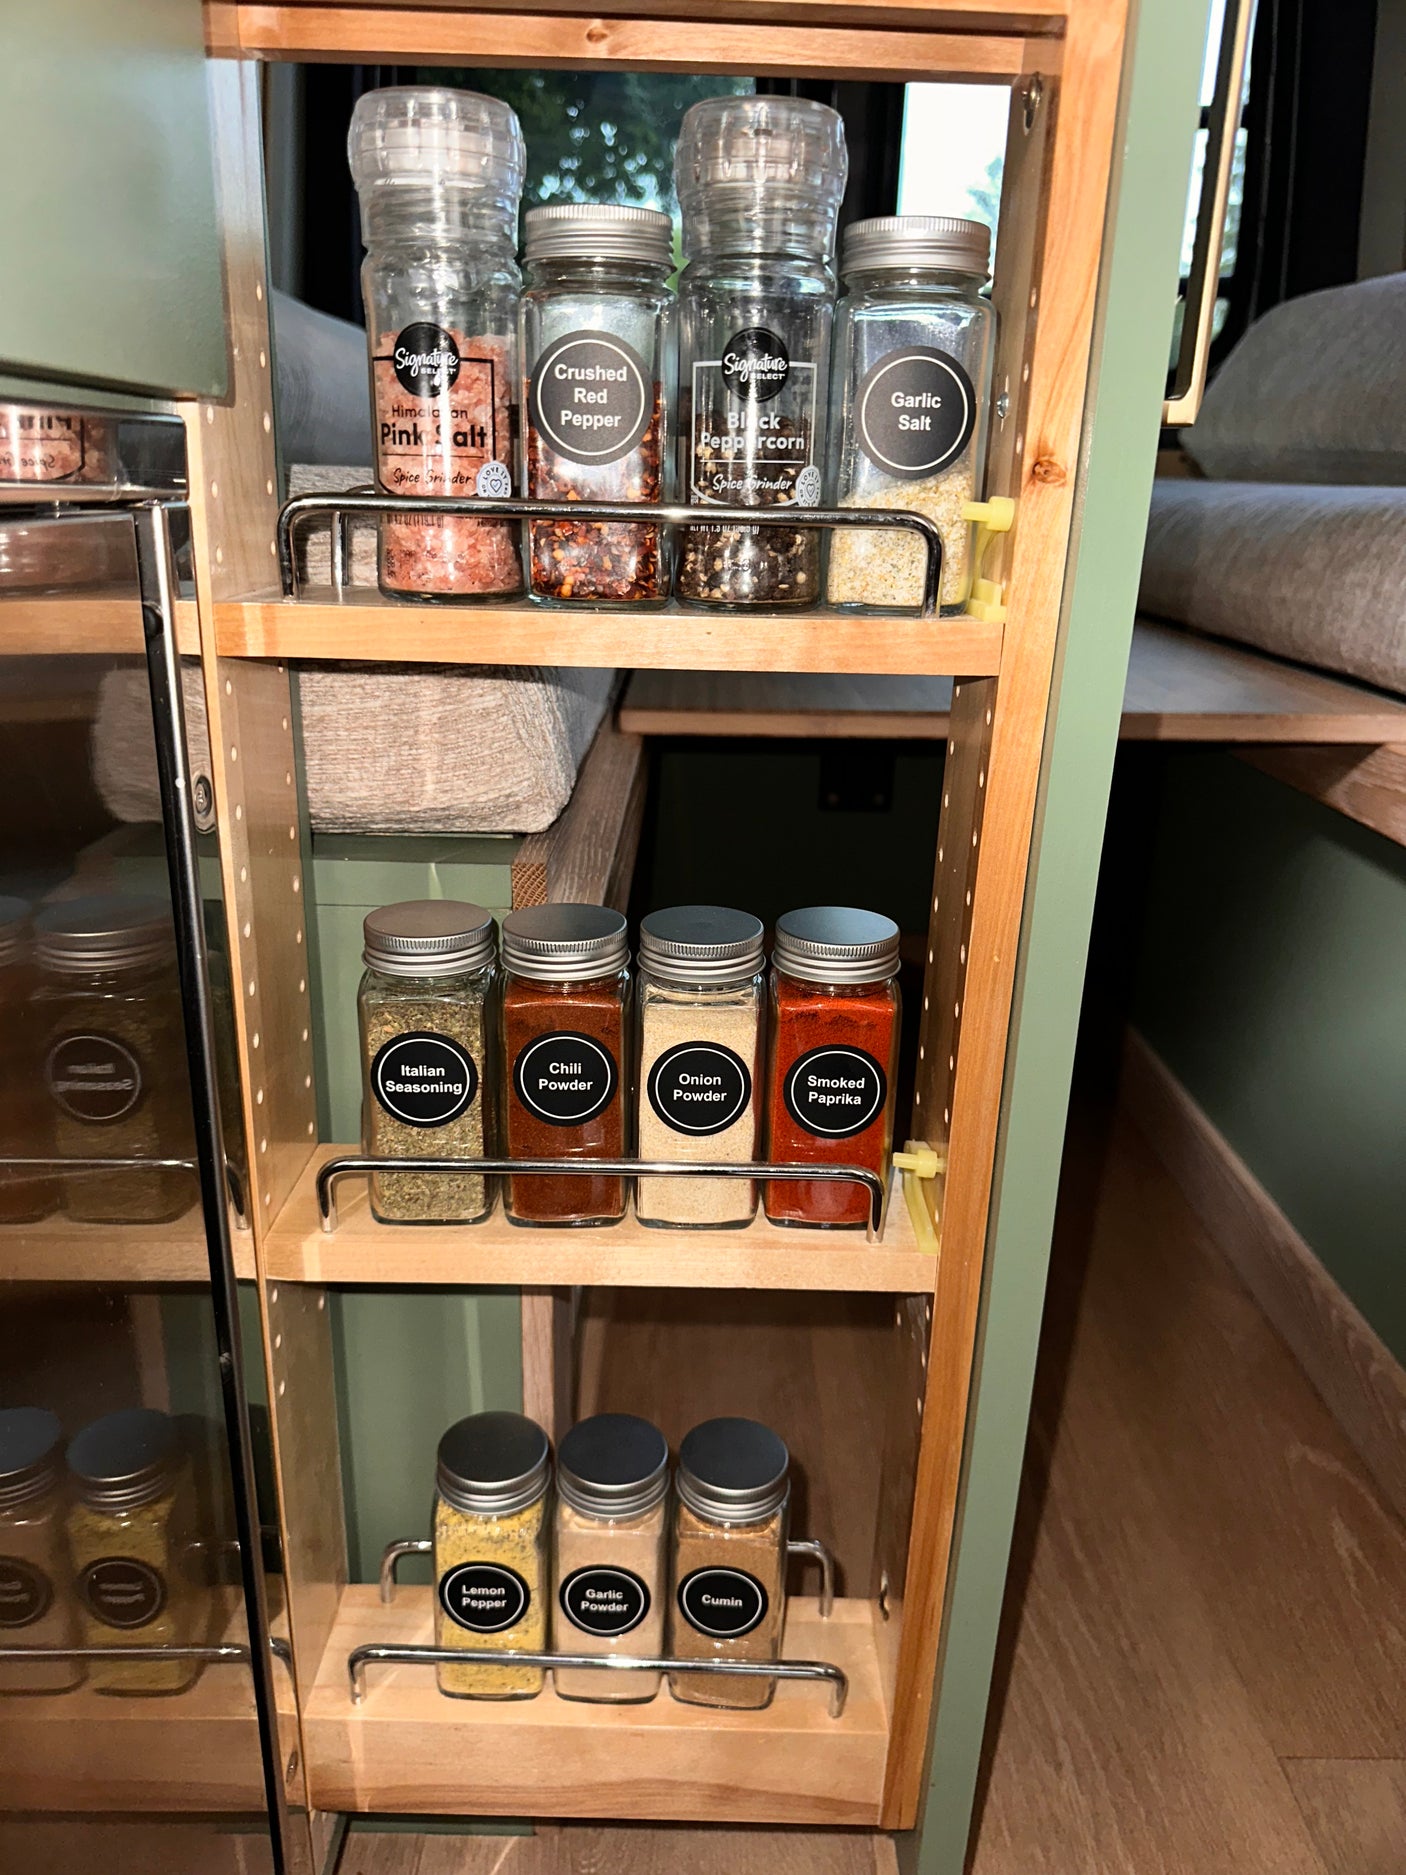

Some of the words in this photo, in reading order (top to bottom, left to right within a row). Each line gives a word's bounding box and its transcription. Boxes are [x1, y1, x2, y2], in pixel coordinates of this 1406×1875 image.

[554, 363, 627, 381] Crushed
[724, 352, 788, 382] Signature
[574, 387, 608, 404] Red
[891, 391, 942, 408] Garlic
[560, 410, 622, 430] Pepper
[727, 411, 781, 429] Blck
[898, 414, 931, 431] Salt
[381, 422, 424, 445] Pink
[701, 431, 805, 452] Pepprcorn
[393, 467, 420, 485] Spice
[712, 473, 743, 493] Spice
[400, 1064, 445, 1077] Italian
[549, 1062, 582, 1075] Chili
[538, 1078, 593, 1091] Powder
[678, 1073, 722, 1086] Onion
[807, 1075, 865, 1089] Smoked
[385, 1080, 463, 1095] Seasoning
[673, 1089, 727, 1102] Powder
[808, 1091, 862, 1106] Paprika
[461, 1584, 506, 1596] Lemon
[585, 1588, 624, 1600] Garlic
[461, 1597, 507, 1610] Pepper
[580, 1600, 629, 1612] Powder
[701, 1594, 743, 1607] Cumin
